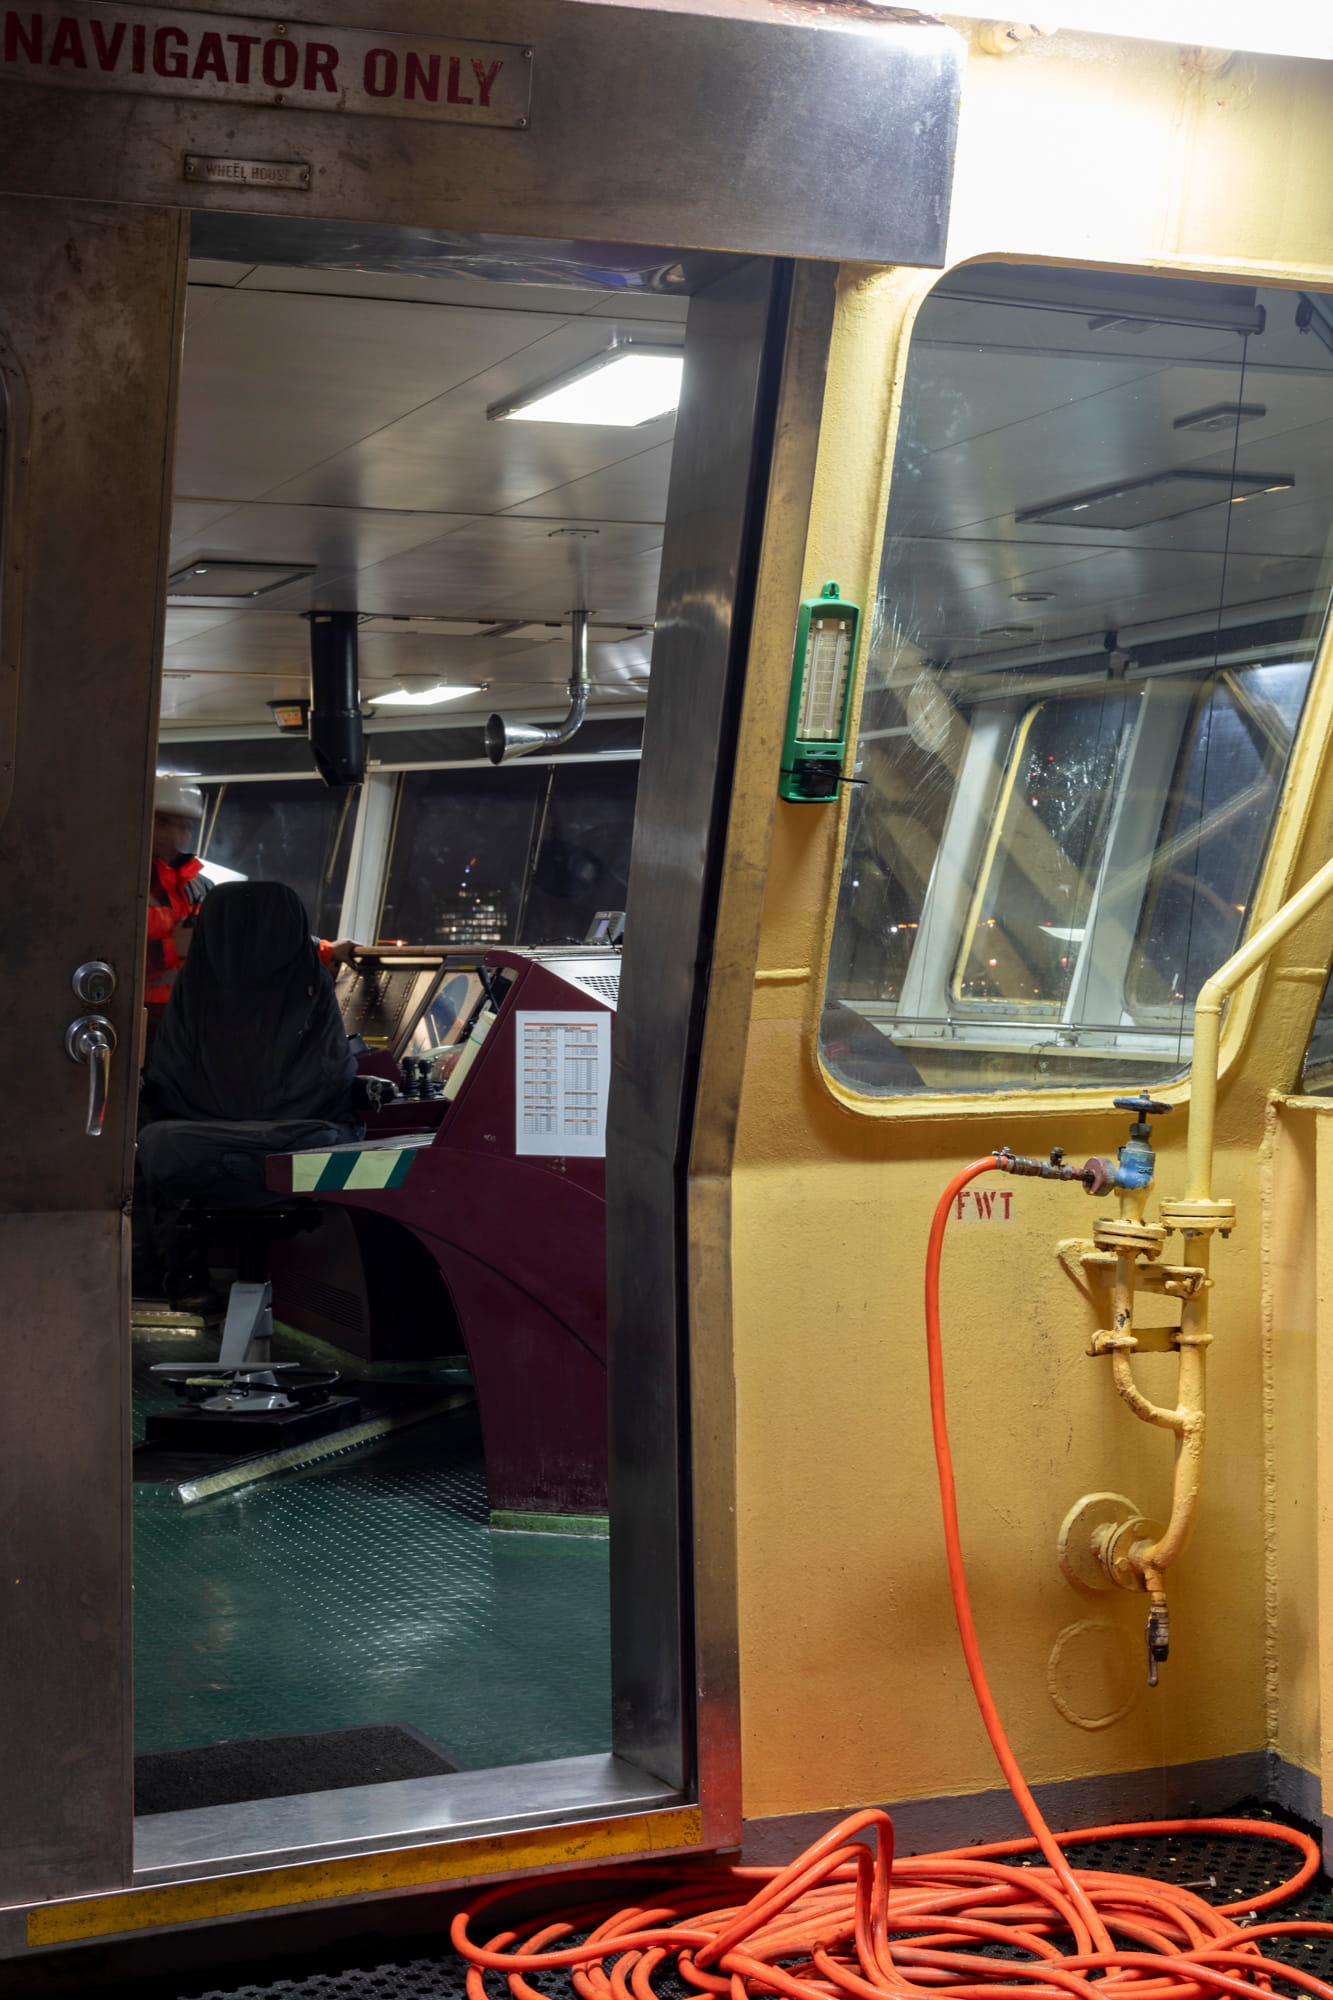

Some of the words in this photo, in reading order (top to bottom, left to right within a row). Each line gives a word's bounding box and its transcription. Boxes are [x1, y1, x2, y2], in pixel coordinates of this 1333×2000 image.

[4, 11, 339, 93] NAVIGATOR
[363, 48, 504, 107] ONLY
[206, 163, 247, 179] WHEEL
[251, 167, 289, 182] HOUSE
[956, 1191, 1014, 1220] FWT
